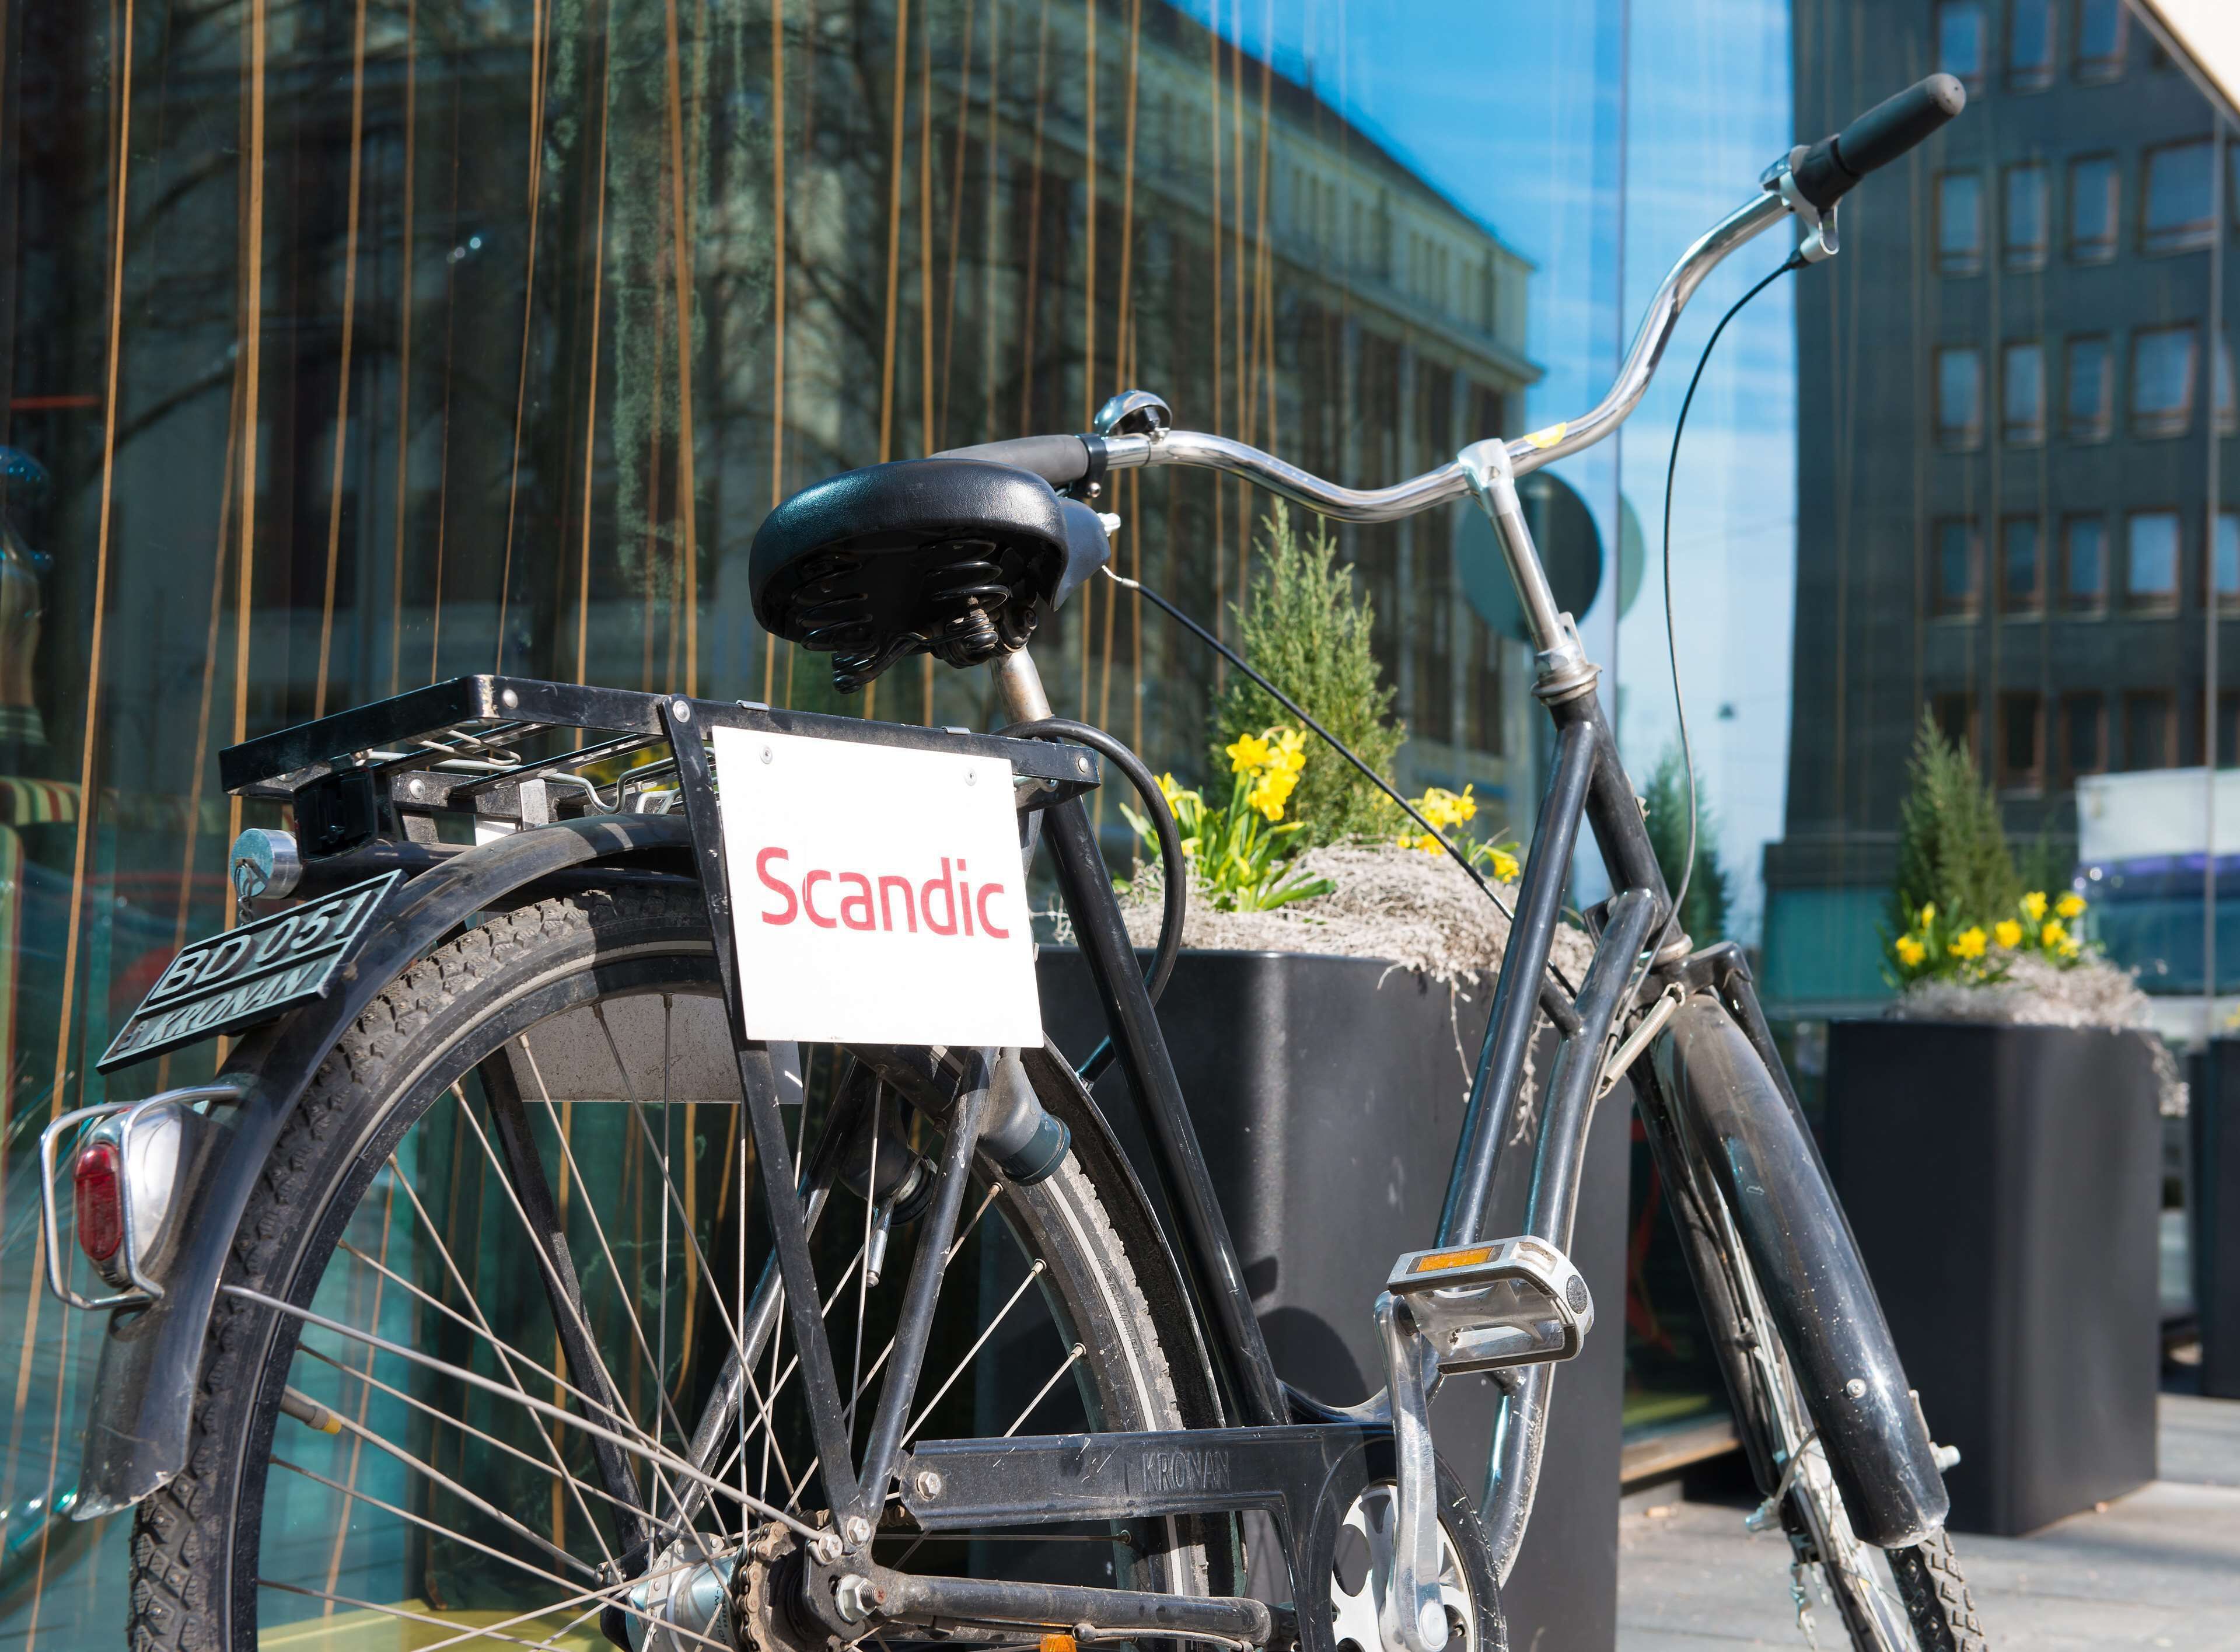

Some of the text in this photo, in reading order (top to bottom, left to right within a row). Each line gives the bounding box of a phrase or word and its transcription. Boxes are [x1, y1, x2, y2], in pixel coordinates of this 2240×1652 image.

[756, 847, 1009, 938] Scandic
[150, 889, 375, 999] BD 051
[142, 968, 312, 1047] KRONAN
[1142, 1450, 1231, 1492] KRONAN
